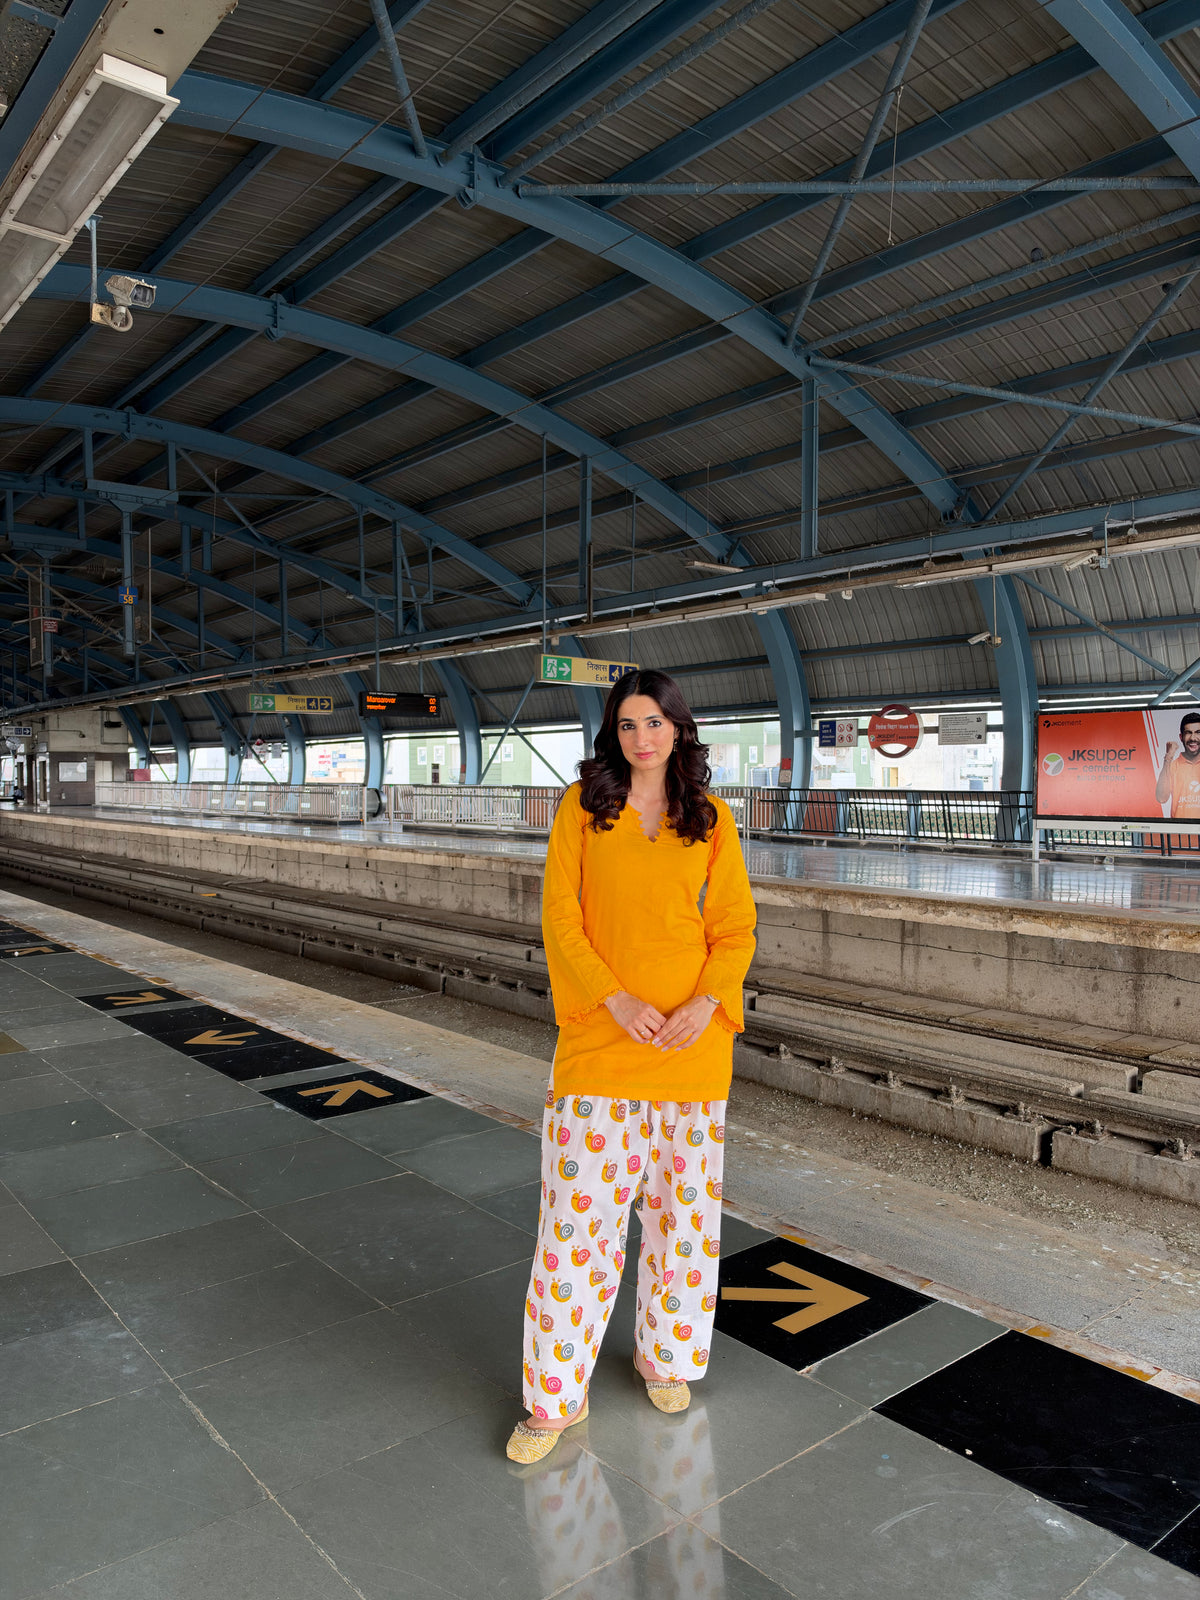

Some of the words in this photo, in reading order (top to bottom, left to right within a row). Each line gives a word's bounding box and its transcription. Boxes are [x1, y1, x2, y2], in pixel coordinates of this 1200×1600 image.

[123, 595, 134, 604] 58
[586, 661, 608, 672] निकास
[595, 674, 608, 682] Exit
[1082, 763, 1121, 773] cement
